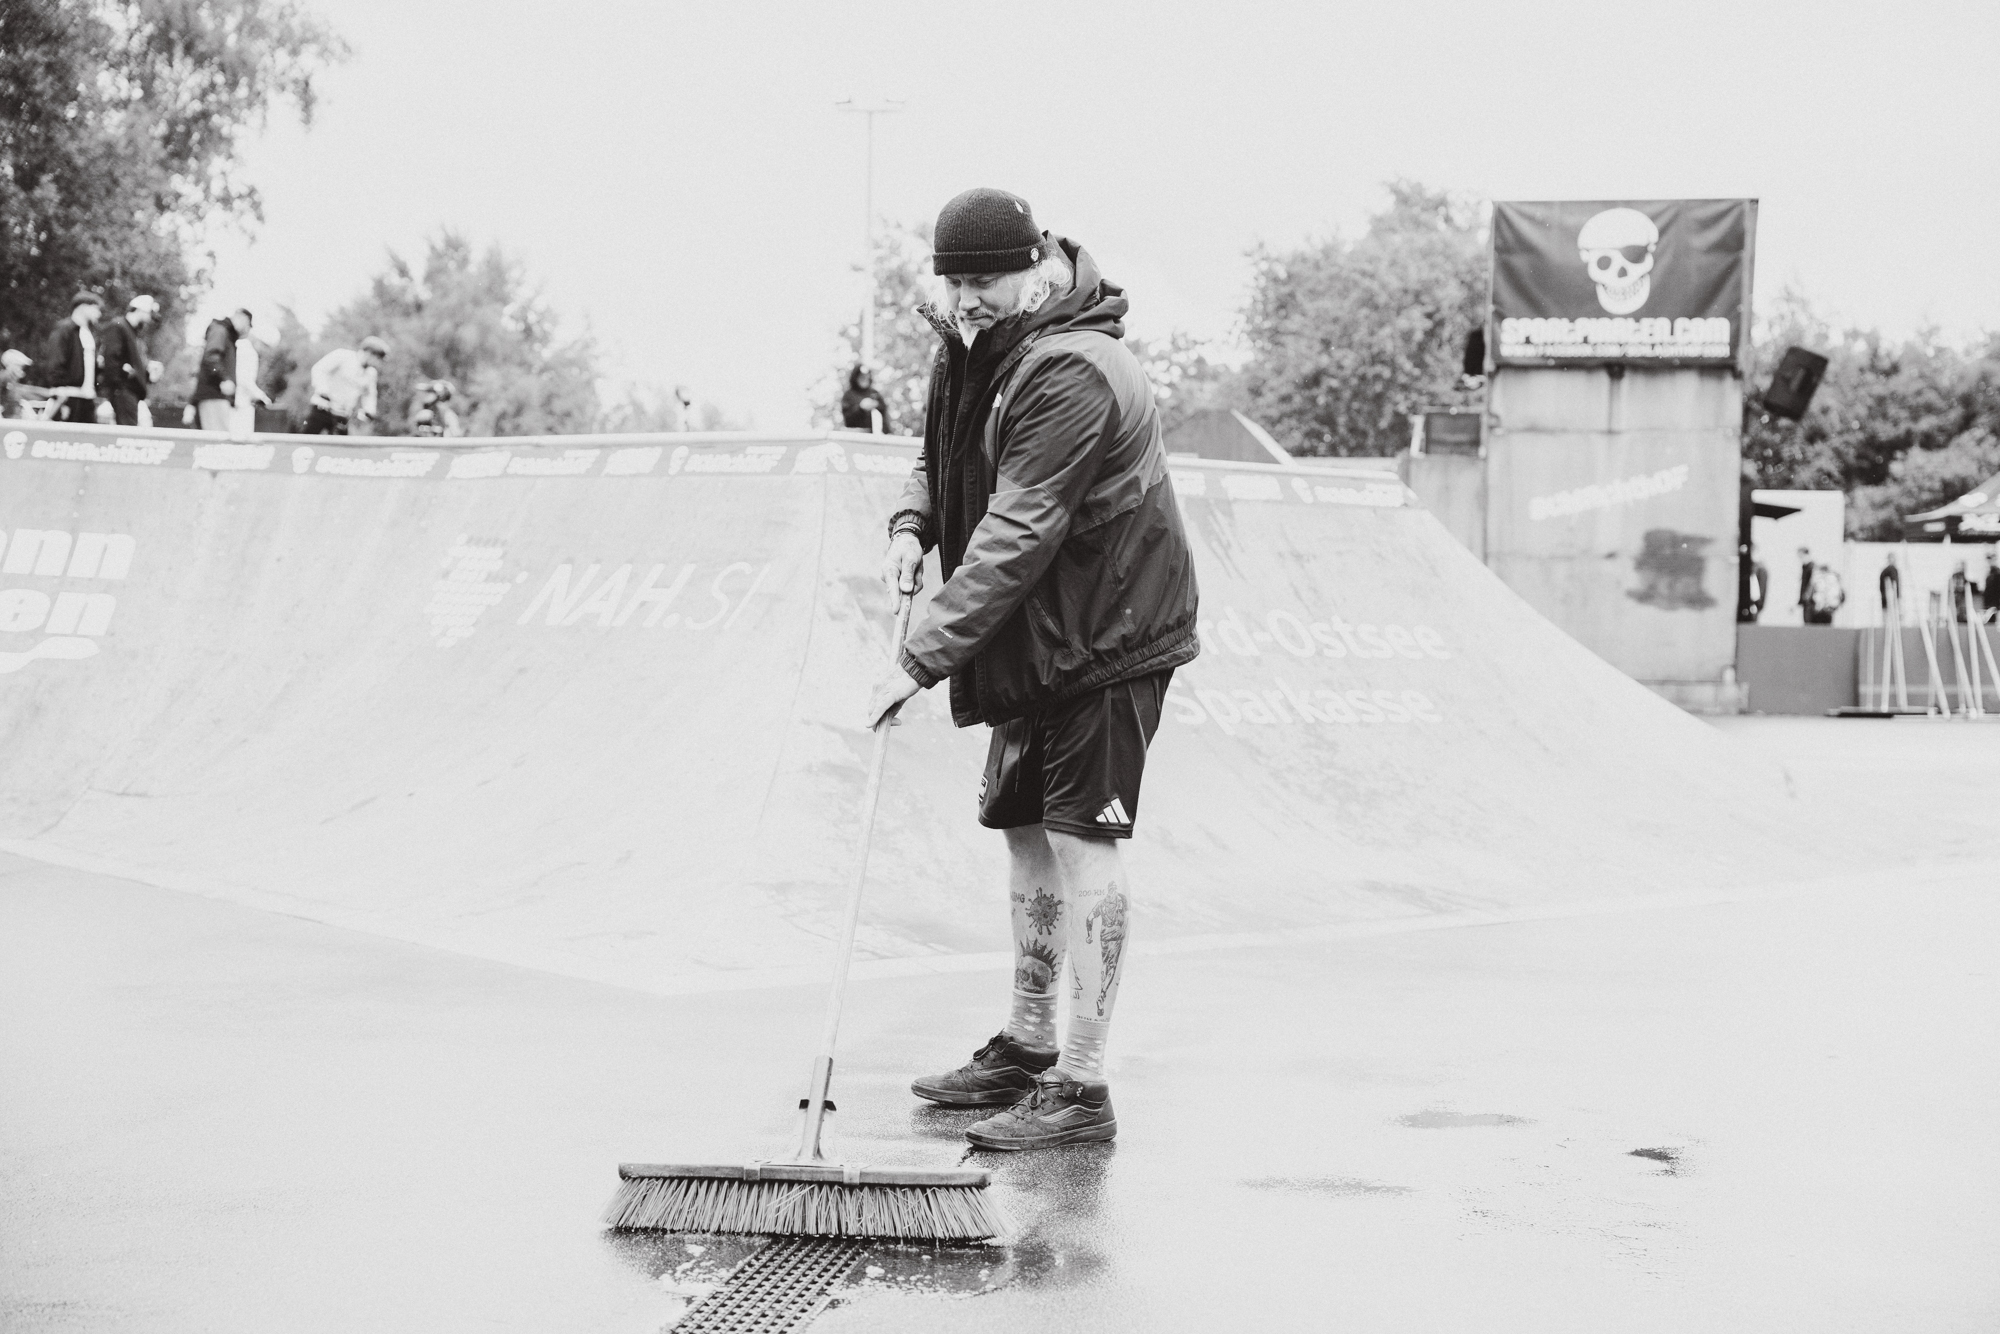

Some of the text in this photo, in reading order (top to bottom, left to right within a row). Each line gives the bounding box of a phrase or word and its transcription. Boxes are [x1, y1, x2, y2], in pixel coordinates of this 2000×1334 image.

[0, 528, 137, 580] nn
[1198, 605, 1452, 660] rd-Ostsee
[1165, 676, 1444, 736] Sparkasse
